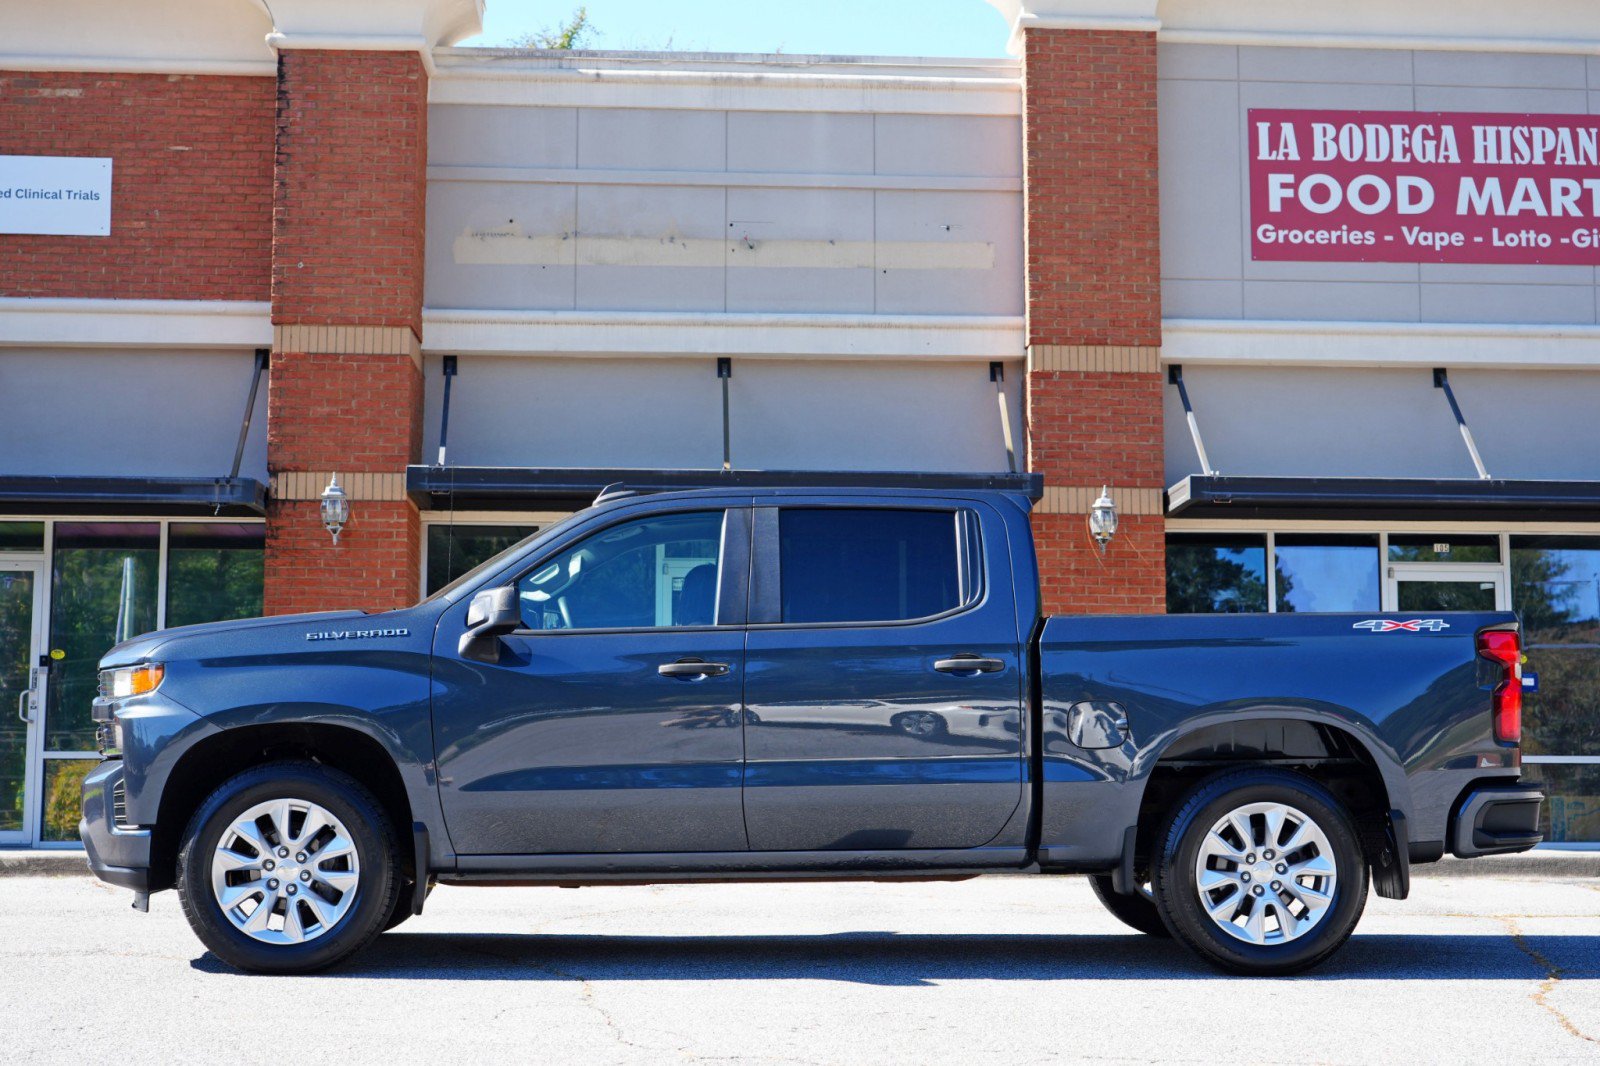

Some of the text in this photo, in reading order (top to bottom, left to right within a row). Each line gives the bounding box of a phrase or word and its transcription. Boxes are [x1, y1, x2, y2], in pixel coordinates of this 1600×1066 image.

[1256, 122, 1600, 166] LA BODEGA HISPAN
[15, 188, 62, 200] Clinical
[66, 189, 100, 201] Trials
[1267, 173, 1600, 218] FOOD MART
[1256, 223, 1376, 245] Groceries
[1401, 226, 1465, 251] Vape
[1492, 227, 1552, 248] Lotto
[1560, 228, 1600, 248] -Gi
[306, 628, 408, 640] SILVERADO
